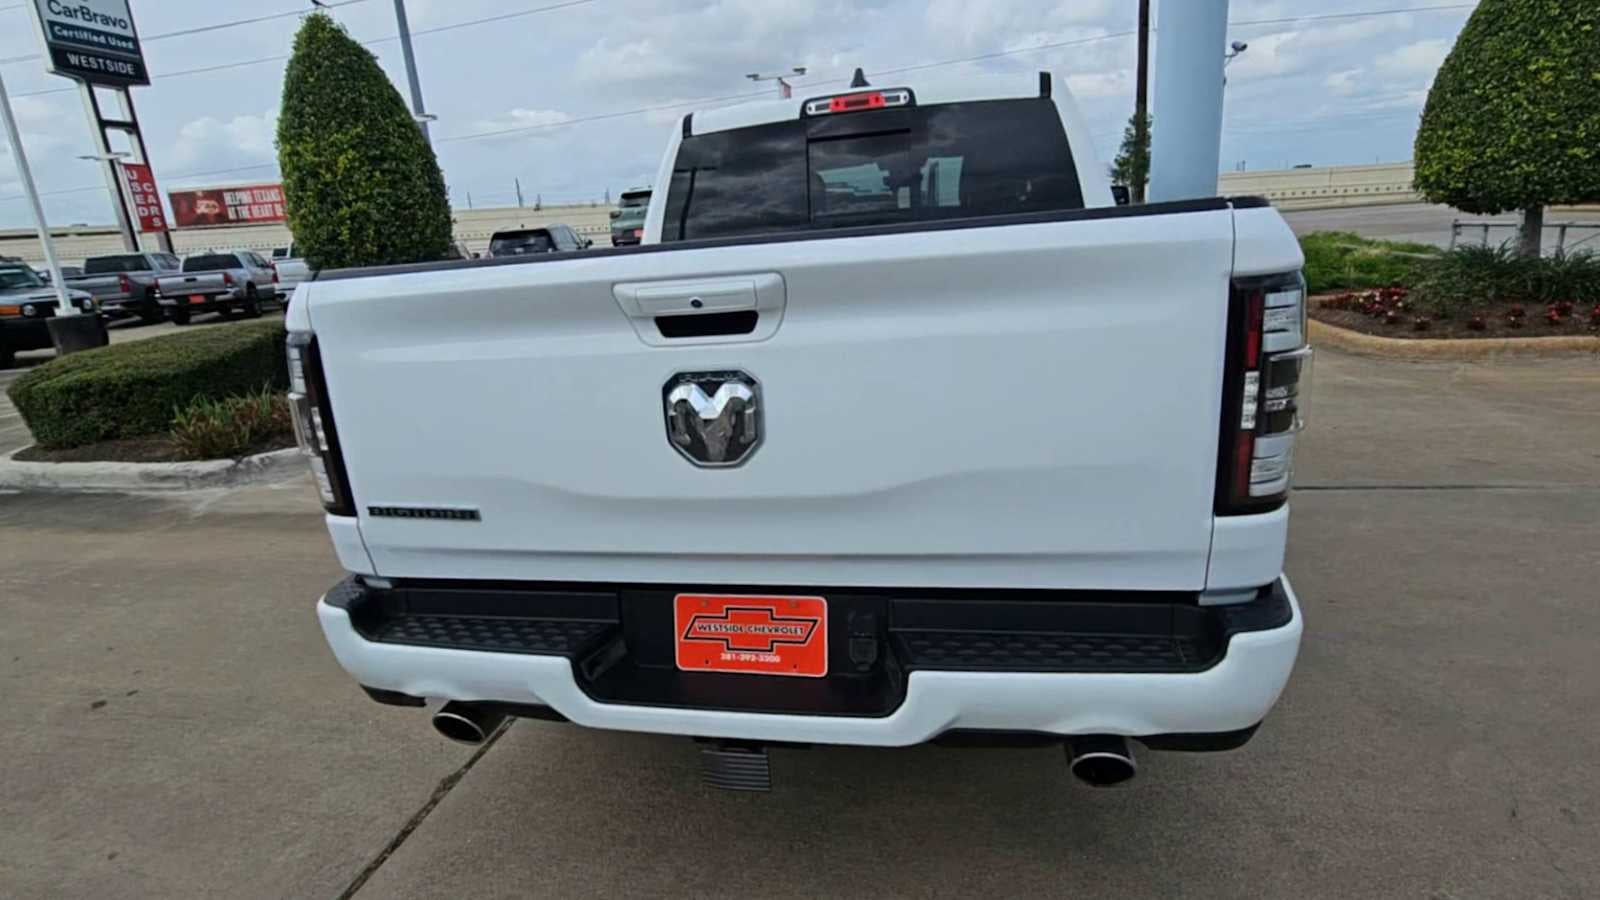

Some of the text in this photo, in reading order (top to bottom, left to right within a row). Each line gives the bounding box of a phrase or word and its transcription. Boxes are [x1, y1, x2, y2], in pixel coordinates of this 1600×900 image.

[47, 0, 128, 30] CarBravo
[53, 26, 135, 49] Certified Used
[66, 53, 136, 76] WESTSIDE
[127, 170, 148, 216] USED
[142, 183, 162, 226] CARS
[697, 624, 804, 635] WESTSIDE CHEVROLET
